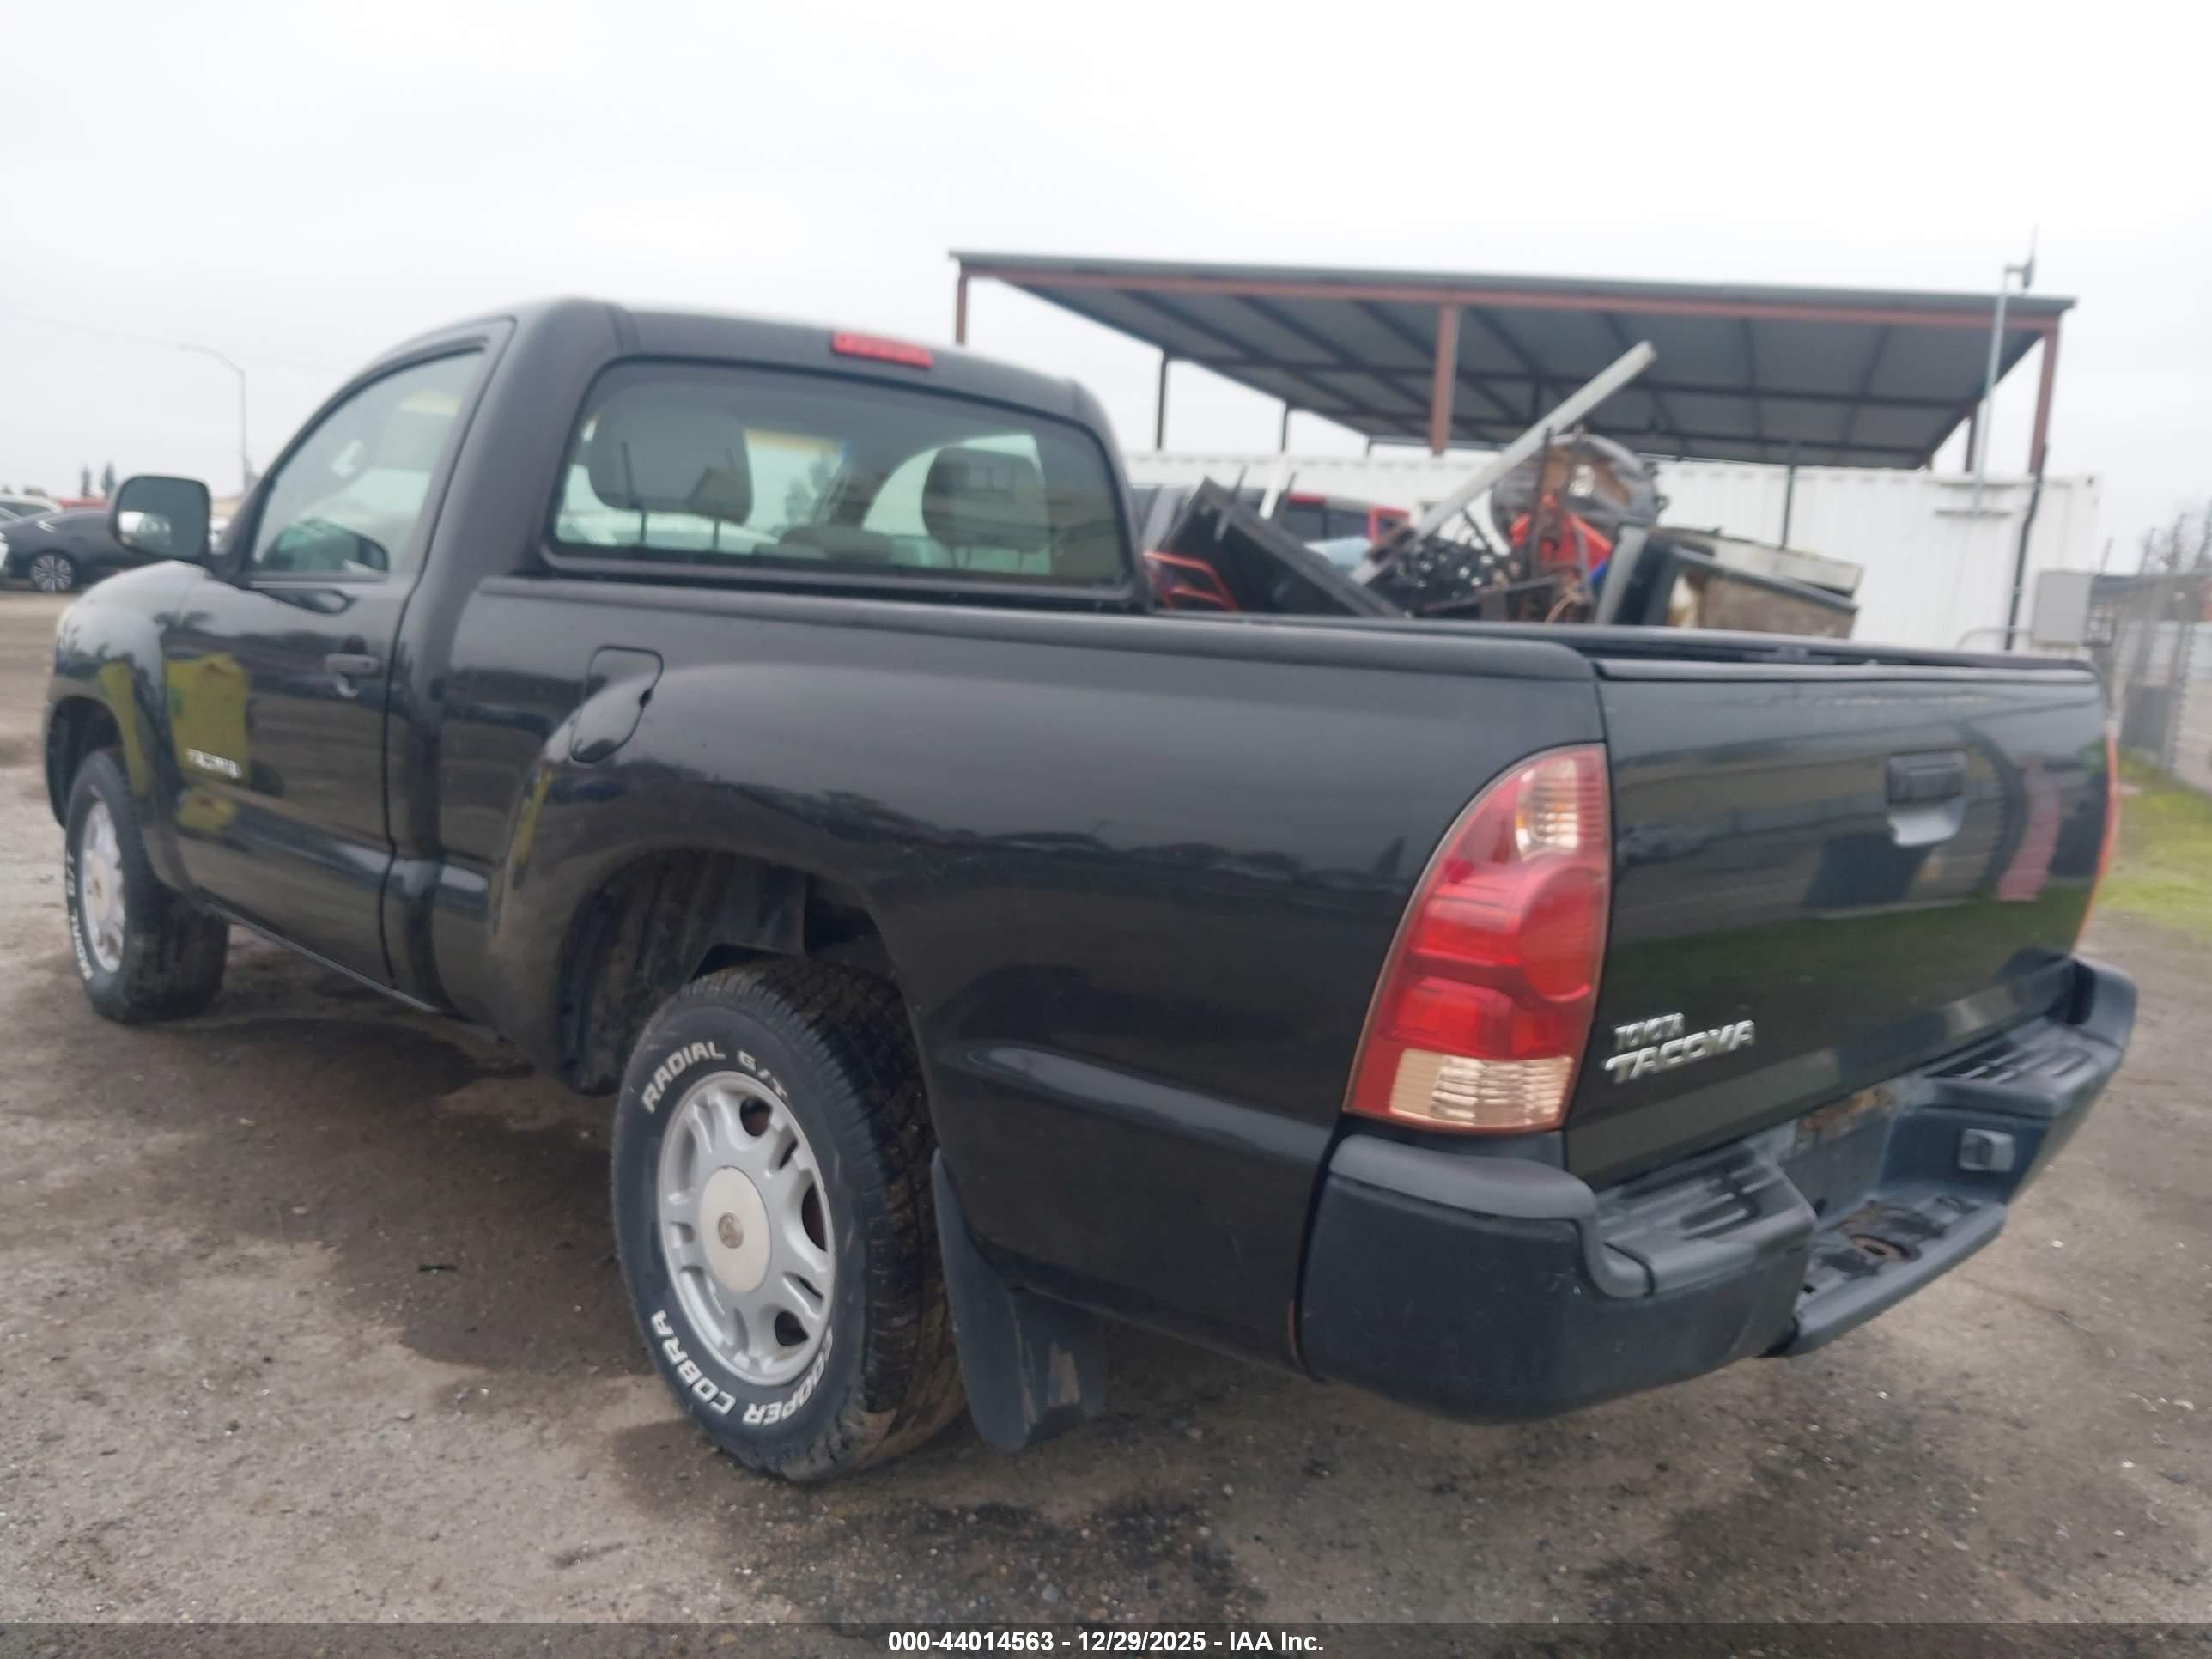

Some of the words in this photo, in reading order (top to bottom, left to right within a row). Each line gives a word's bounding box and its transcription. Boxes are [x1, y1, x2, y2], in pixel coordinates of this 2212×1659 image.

[641, 1041, 727, 1114] RADIAL
[1604, 1018, 1756, 1085] TACOMA
[651, 1309, 737, 1415] COBRA
